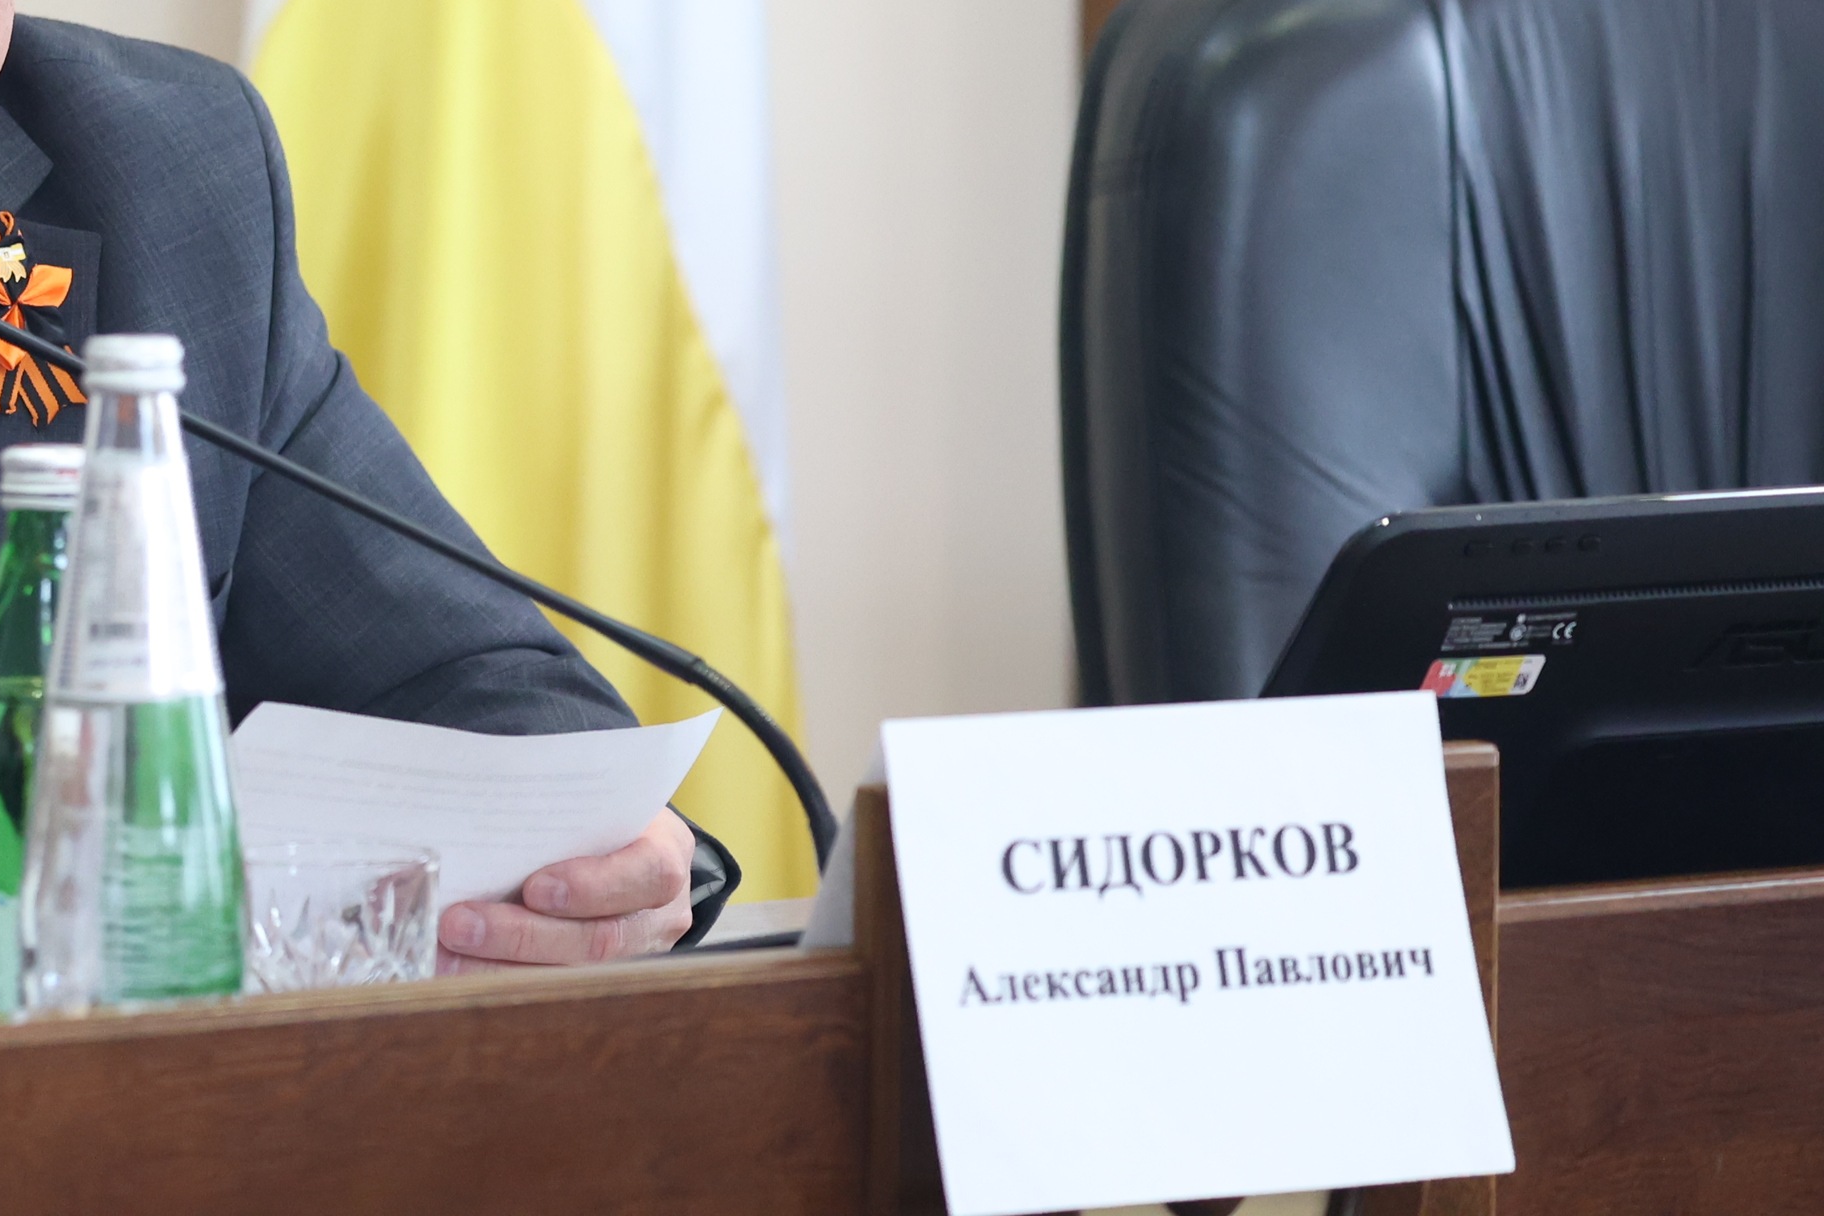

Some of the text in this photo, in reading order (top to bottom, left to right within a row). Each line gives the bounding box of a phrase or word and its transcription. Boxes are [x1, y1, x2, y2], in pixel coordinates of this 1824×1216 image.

[1001, 822, 1359, 897] СИДОРКОВ
[960, 946, 1433, 1004] Александр Павлович
